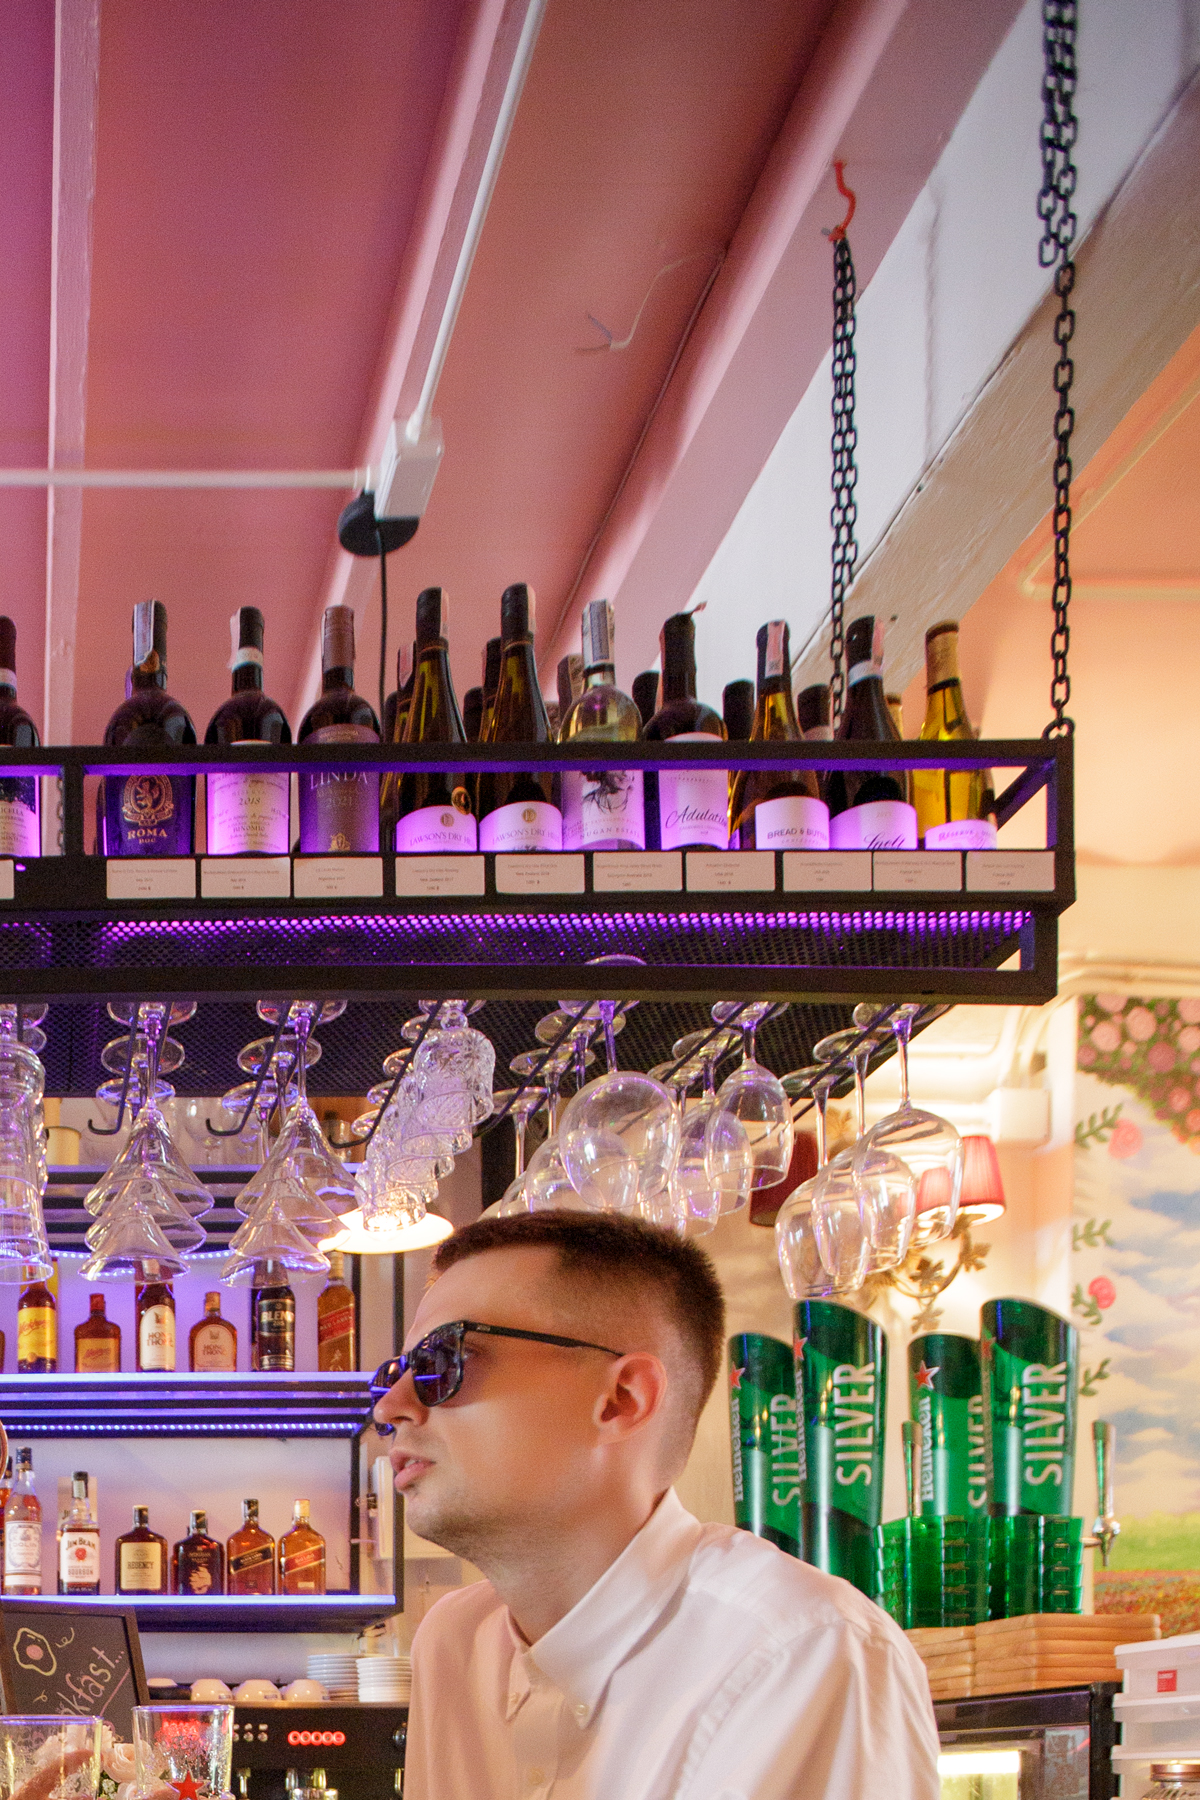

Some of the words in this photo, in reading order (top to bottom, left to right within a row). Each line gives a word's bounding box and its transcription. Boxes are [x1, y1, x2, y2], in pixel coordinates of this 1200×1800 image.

[239, 798, 261, 806] 2018
[127, 829, 168, 840] ROMA
[409, 832, 447, 847] LAWSON'S
[448, 834, 463, 842] DRY
[492, 830, 529, 846] LAWSON'S
[530, 830, 546, 838] DRY
[767, 828, 798, 840] BREAD
[833, 1361, 875, 1486] SILVER
[1022, 1361, 1067, 1486] SILVER
[918, 1396, 934, 1501] Heineken
[67, 1539, 77, 1550] JIM
[78, 1537, 96, 1550] BEAM
[68, 1567, 94, 1575] BOURBON
[127, 1562, 154, 1570] REGENCY
